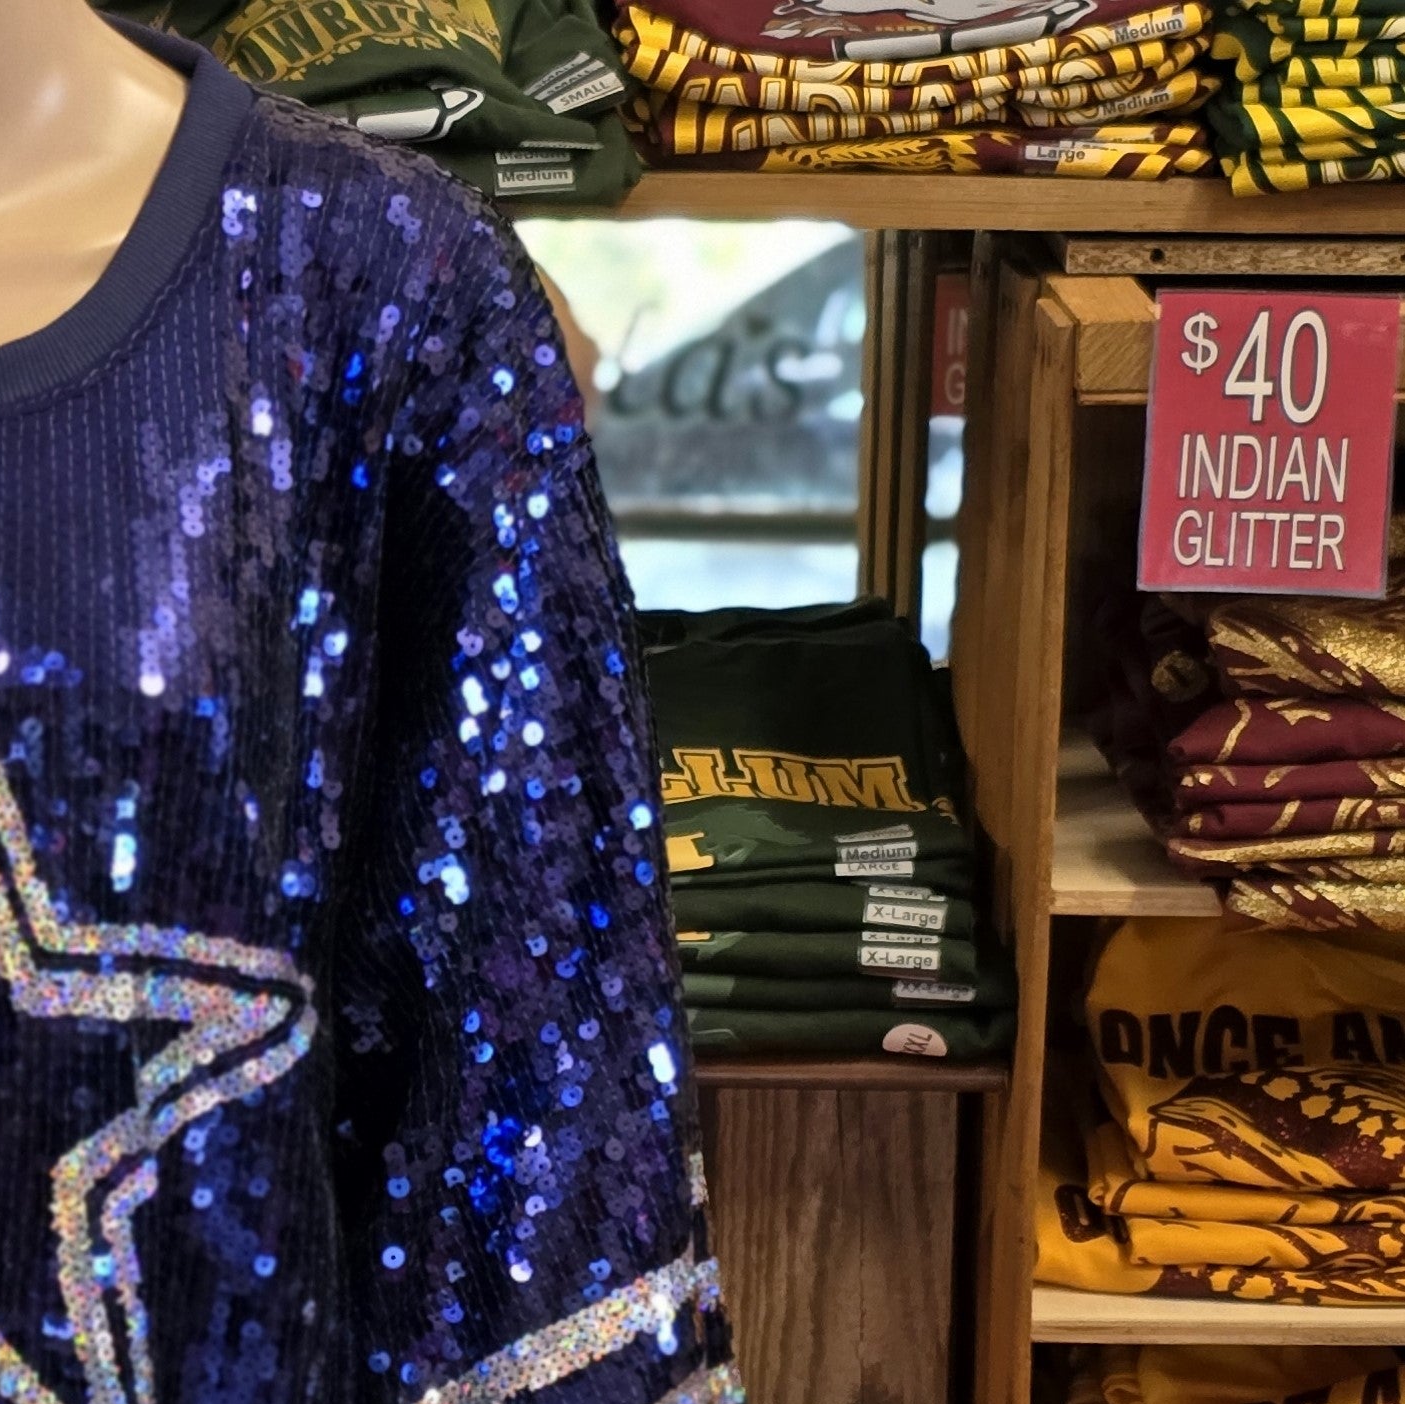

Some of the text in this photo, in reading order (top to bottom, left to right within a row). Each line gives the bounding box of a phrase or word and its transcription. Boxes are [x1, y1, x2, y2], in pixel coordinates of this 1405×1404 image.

[1115, 17, 1182, 43] Medium
[560, 81, 610, 107] SMALL
[1103, 91, 1170, 117] Medium
[1036, 145, 1086, 162] Large
[501, 170, 569, 183] Medium
[1180, 310, 1328, 425] $40
[1178, 433, 1349, 503] INDIAN
[1172, 509, 1345, 571] GLITTER
[846, 845, 913, 861] Medium
[872, 905, 938, 928] X-Large
[866, 951, 933, 969] X-Large
[1099, 1004, 1305, 1079] ONCE
